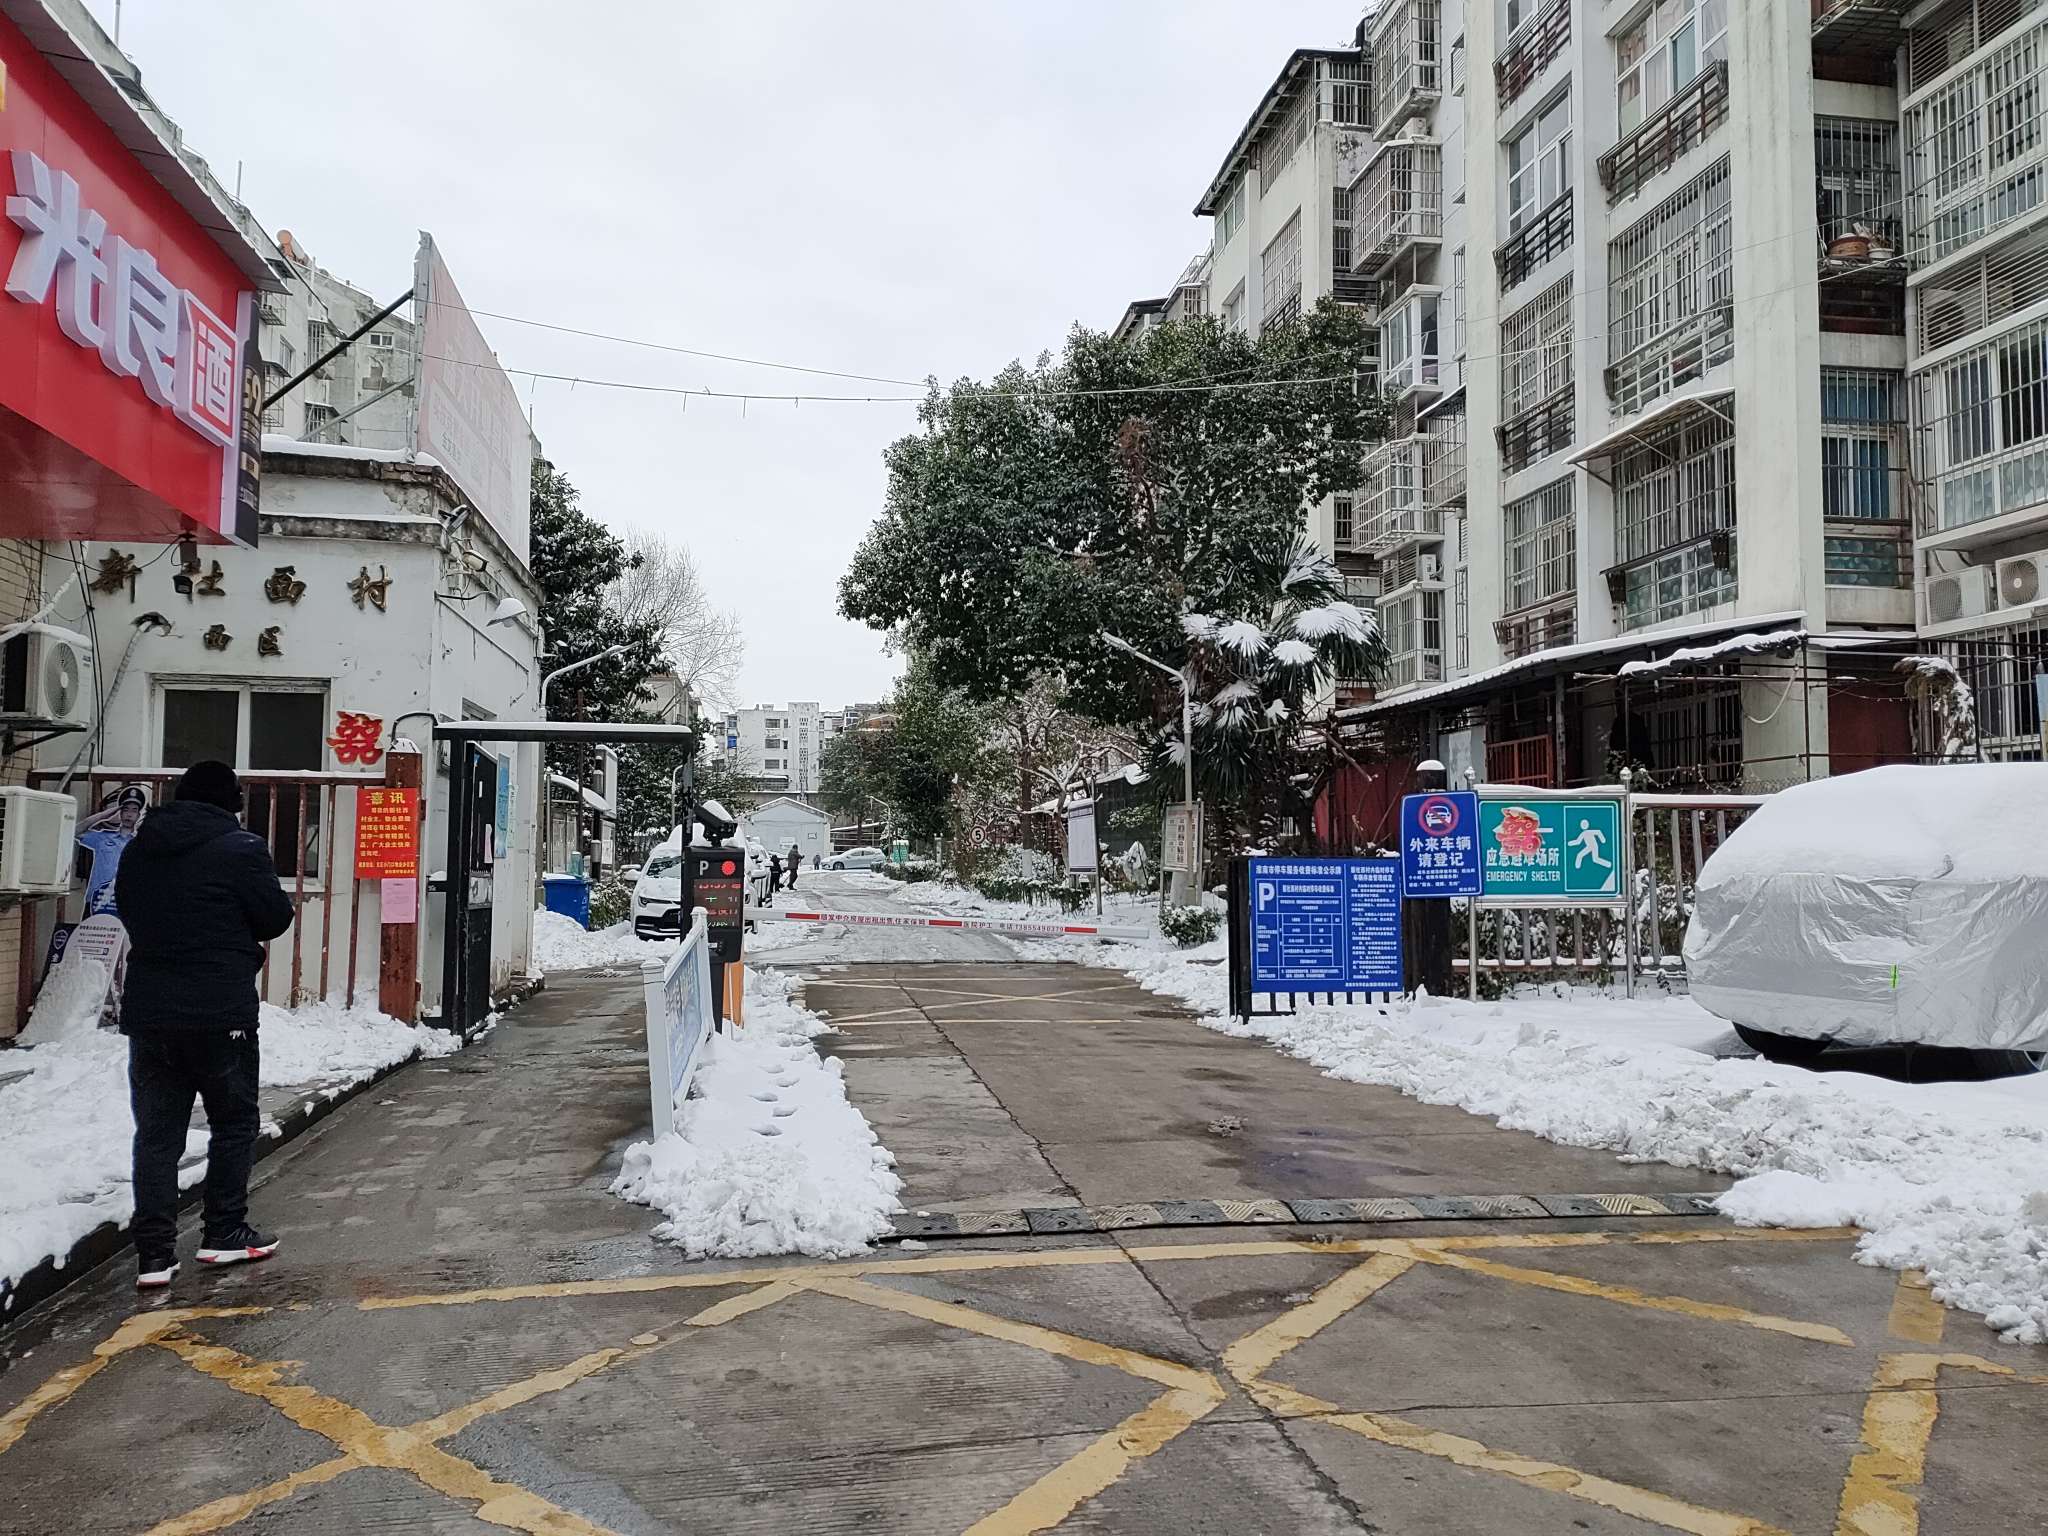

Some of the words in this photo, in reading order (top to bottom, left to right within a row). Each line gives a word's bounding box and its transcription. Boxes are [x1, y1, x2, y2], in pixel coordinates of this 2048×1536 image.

[370, 792, 405, 805] 喜讯
[975, 830, 981, 840] 5
[1409, 836, 1472, 852] 外来车辆
[699, 860, 710, 876] P
[1417, 853, 1465, 868] 请登记
[1486, 871, 1527, 882] EMERGENCY
[1531, 871, 1560, 882] SHELTER
[1258, 882, 1275, 911] P
